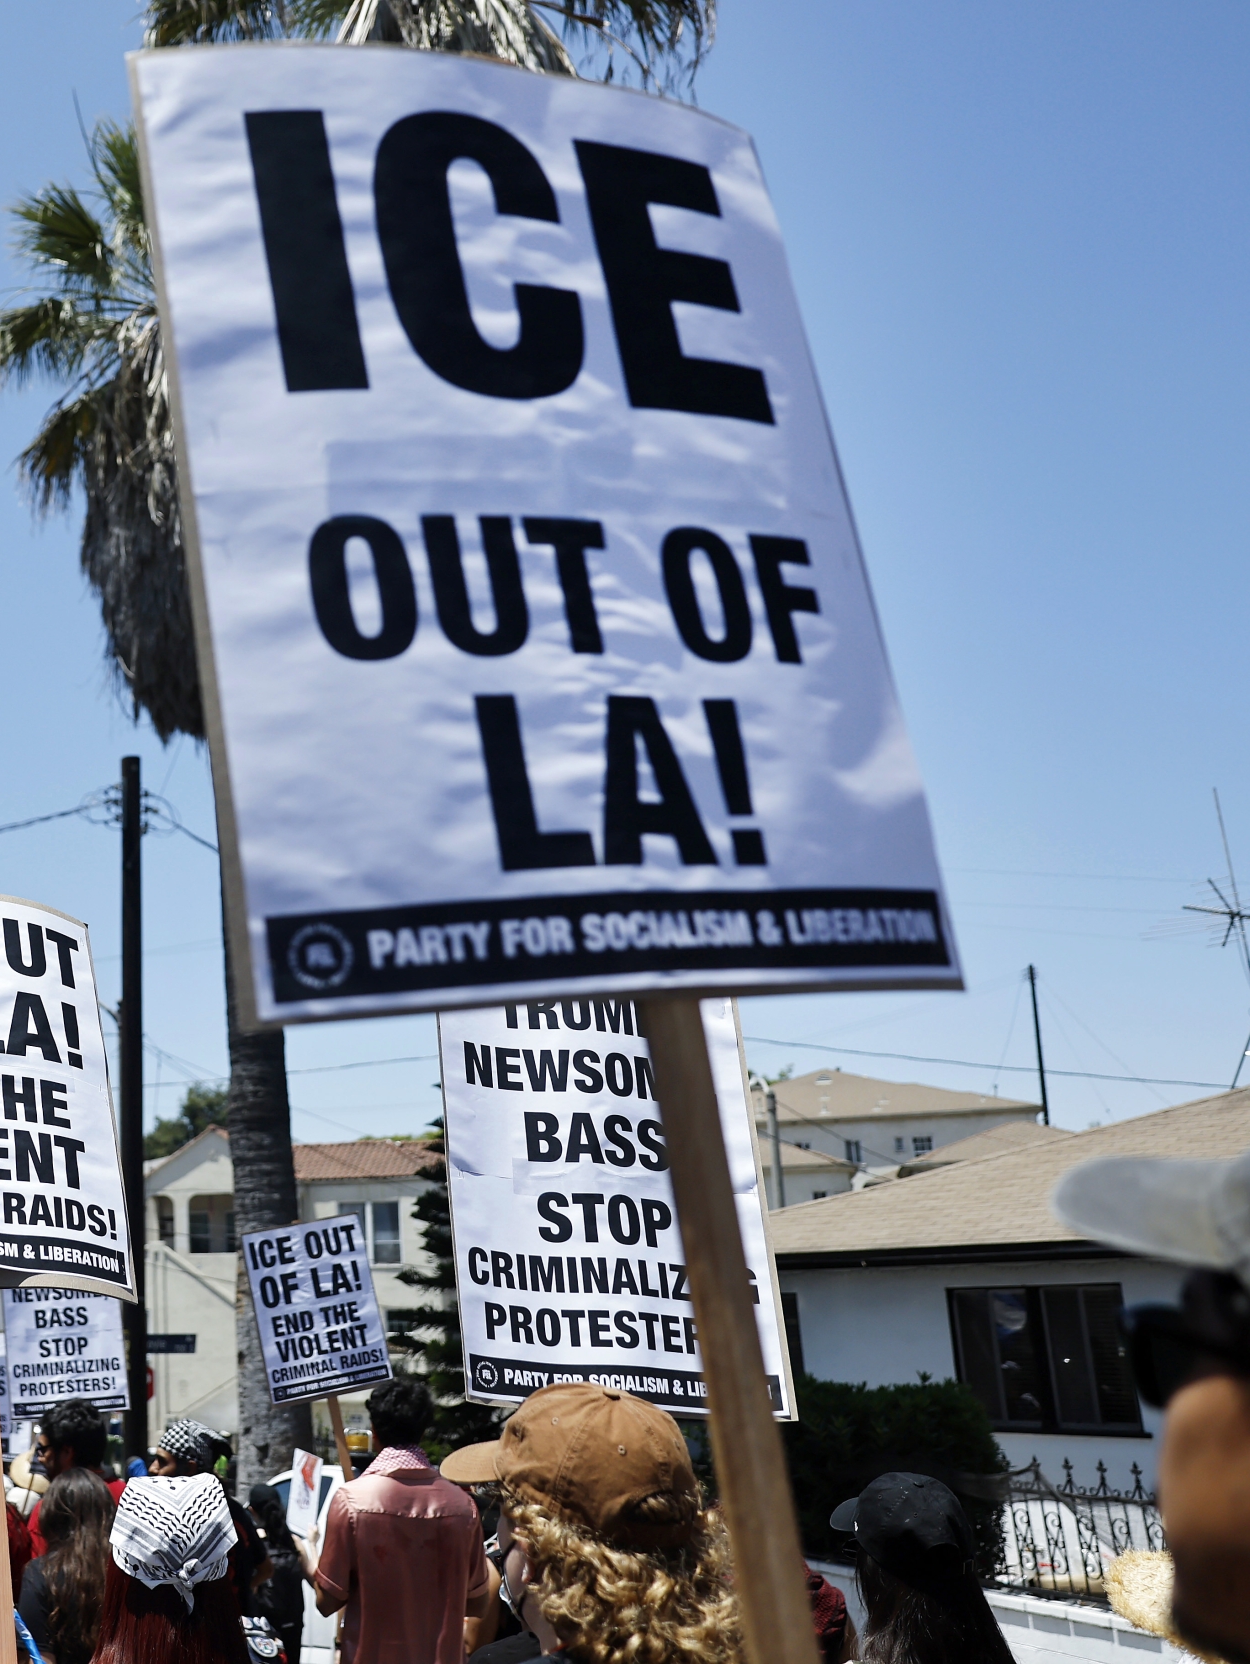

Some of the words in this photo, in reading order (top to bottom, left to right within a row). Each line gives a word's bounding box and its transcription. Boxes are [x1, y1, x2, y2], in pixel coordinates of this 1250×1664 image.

[244, 110, 776, 426] ICE
[308, 513, 607, 661] OUT
[661, 525, 821, 665] OF
[473, 693, 768, 873] LA!
[367, 921, 492, 968] PARTY
[501, 915, 575, 958] FOR
[581, 909, 752, 952] SOCIALISM
[756, 908, 782, 945] &
[786, 907, 938, 946] LIBERATION
[505, 1000, 647, 1038] RUM
[463, 1040, 658, 1102] NEWSO
[524, 1111, 670, 1172] BASS
[3, 1191, 118, 1241] RAIDS!
[537, 1192, 672, 1248] STOP
[23, 1242, 36, 1260] &
[40, 1245, 120, 1274] LIBERATION
[249, 1236, 296, 1270] ICE
[304, 1224, 356, 1259] OUT
[259, 1272, 298, 1308] OF
[310, 1260, 362, 1299] LA!
[34, 1306, 89, 1329] BASS
[271, 1310, 314, 1337] END
[319, 1301, 361, 1328] THE
[39, 1336, 88, 1358] STOP
[275, 1324, 368, 1363] VIOLENT
[13, 1357, 120, 1378] CRIMINALIZING
[20, 1376, 117, 1397] PROTESTERS!
[272, 1358, 338, 1384] CRIMINAL
[341, 1348, 384, 1369] RAIDS!
[504, 1368, 549, 1388] PARTY
[589, 1374, 670, 1395] SOCIALISM
[673, 1380, 684, 1395] &
